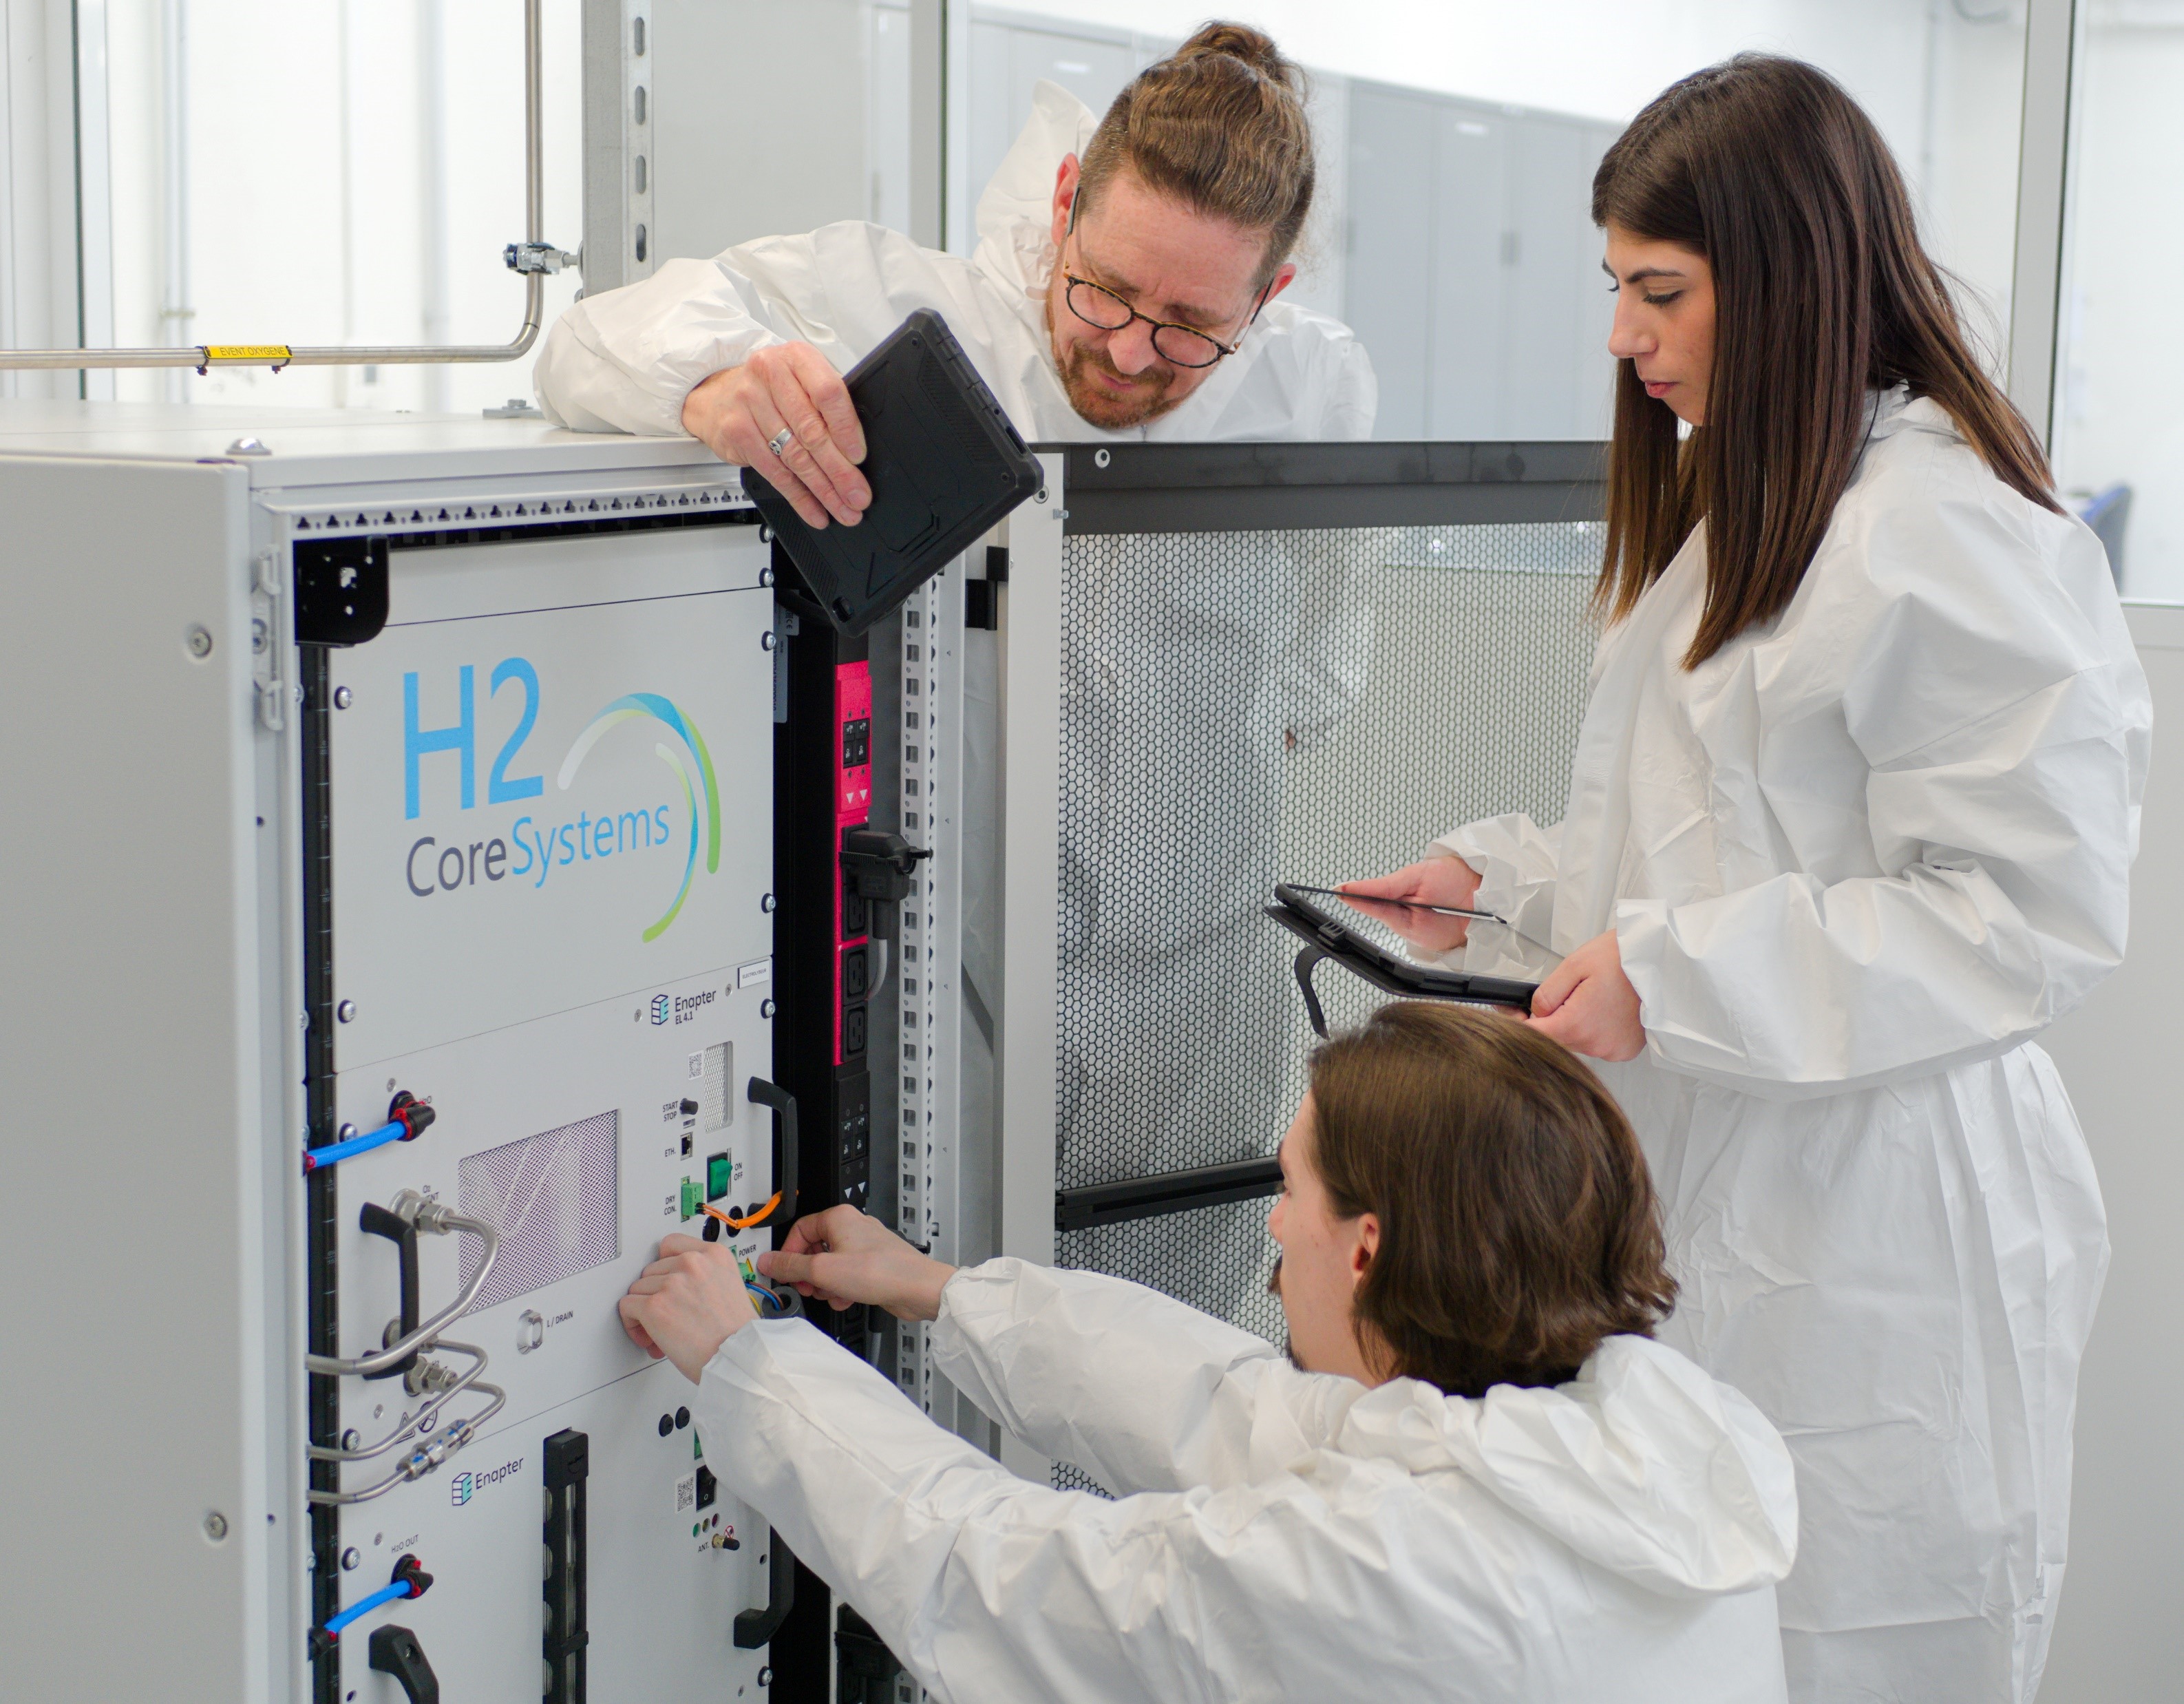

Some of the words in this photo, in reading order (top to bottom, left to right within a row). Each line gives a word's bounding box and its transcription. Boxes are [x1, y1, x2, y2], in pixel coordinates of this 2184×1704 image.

[220, 347, 246, 356] EVENT
[248, 347, 286, 356] OXYGENE
[403, 657, 544, 820] H2
[675, 990, 717, 1011] Enapter
[675, 1014, 683, 1024] EL
[683, 1011, 693, 1022] 4.1
[662, 1101, 678, 1113] START
[664, 1111, 677, 1122] STOP
[665, 1148, 676, 1157] ETH.
[734, 1163, 743, 1171] ON
[734, 1172, 743, 1181] OFF
[665, 1194, 676, 1205] DRY
[664, 1206, 677, 1215] CON.
[739, 1244, 756, 1257] POWER
[555, 1310, 573, 1324] DRAIN
[476, 1458, 524, 1490] Enapter
[405, 1534, 419, 1548] OUT
